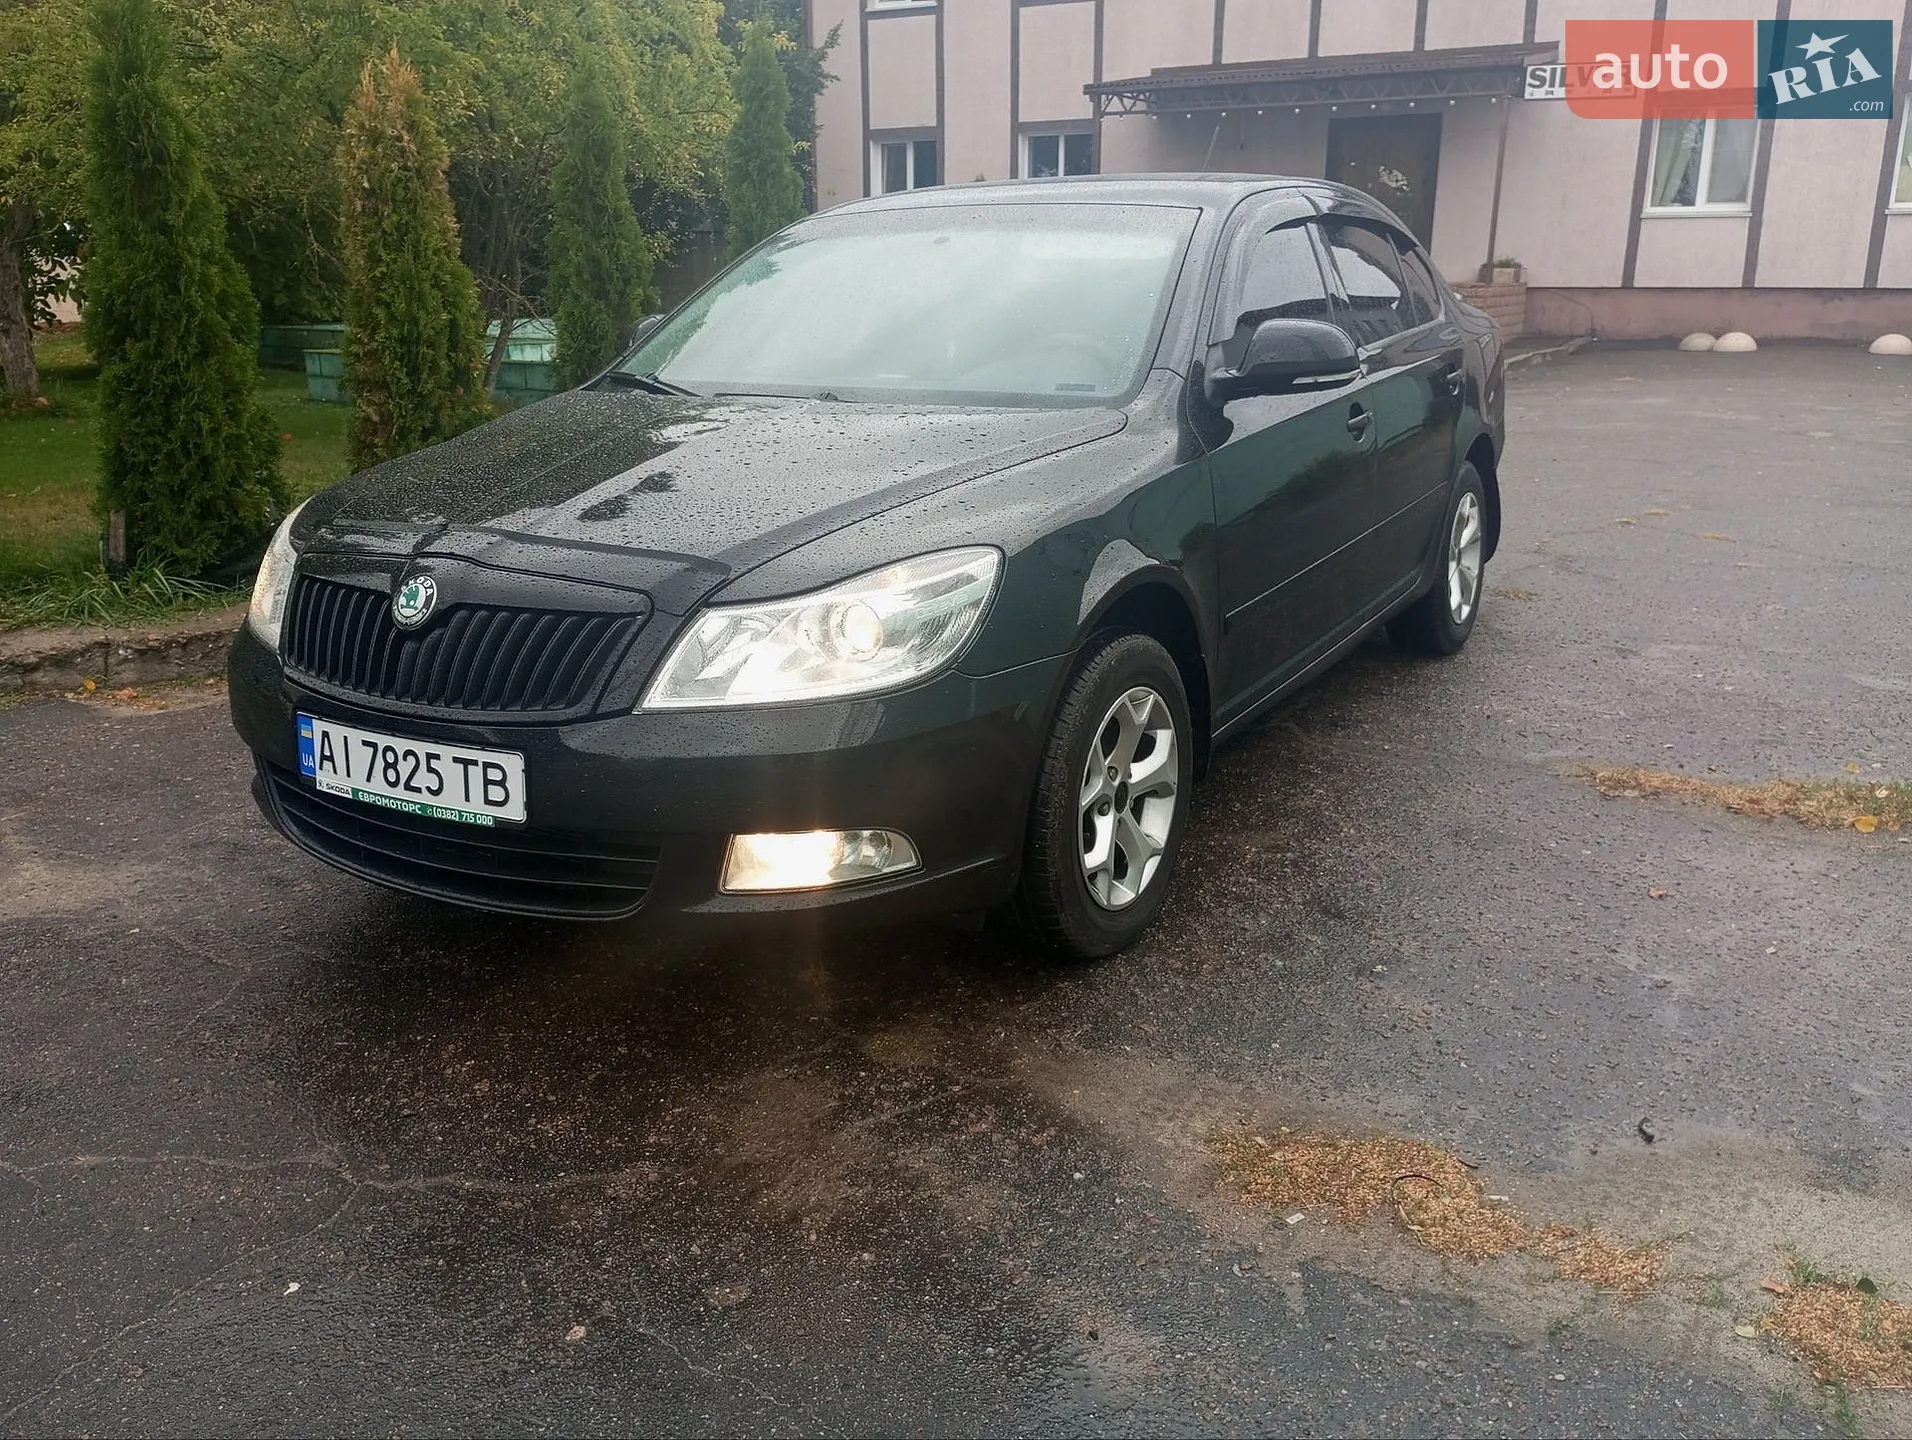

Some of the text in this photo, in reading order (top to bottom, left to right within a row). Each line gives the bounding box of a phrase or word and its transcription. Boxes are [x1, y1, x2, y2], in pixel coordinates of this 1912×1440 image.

[1527, 66, 1632, 89] SILVR
[302, 753, 314, 768] UA
[318, 730, 510, 808] AI 7825 TB
[433, 808, 458, 821] (0382)
[462, 812, 476, 823] 715
[476, 814, 493, 826] 000
